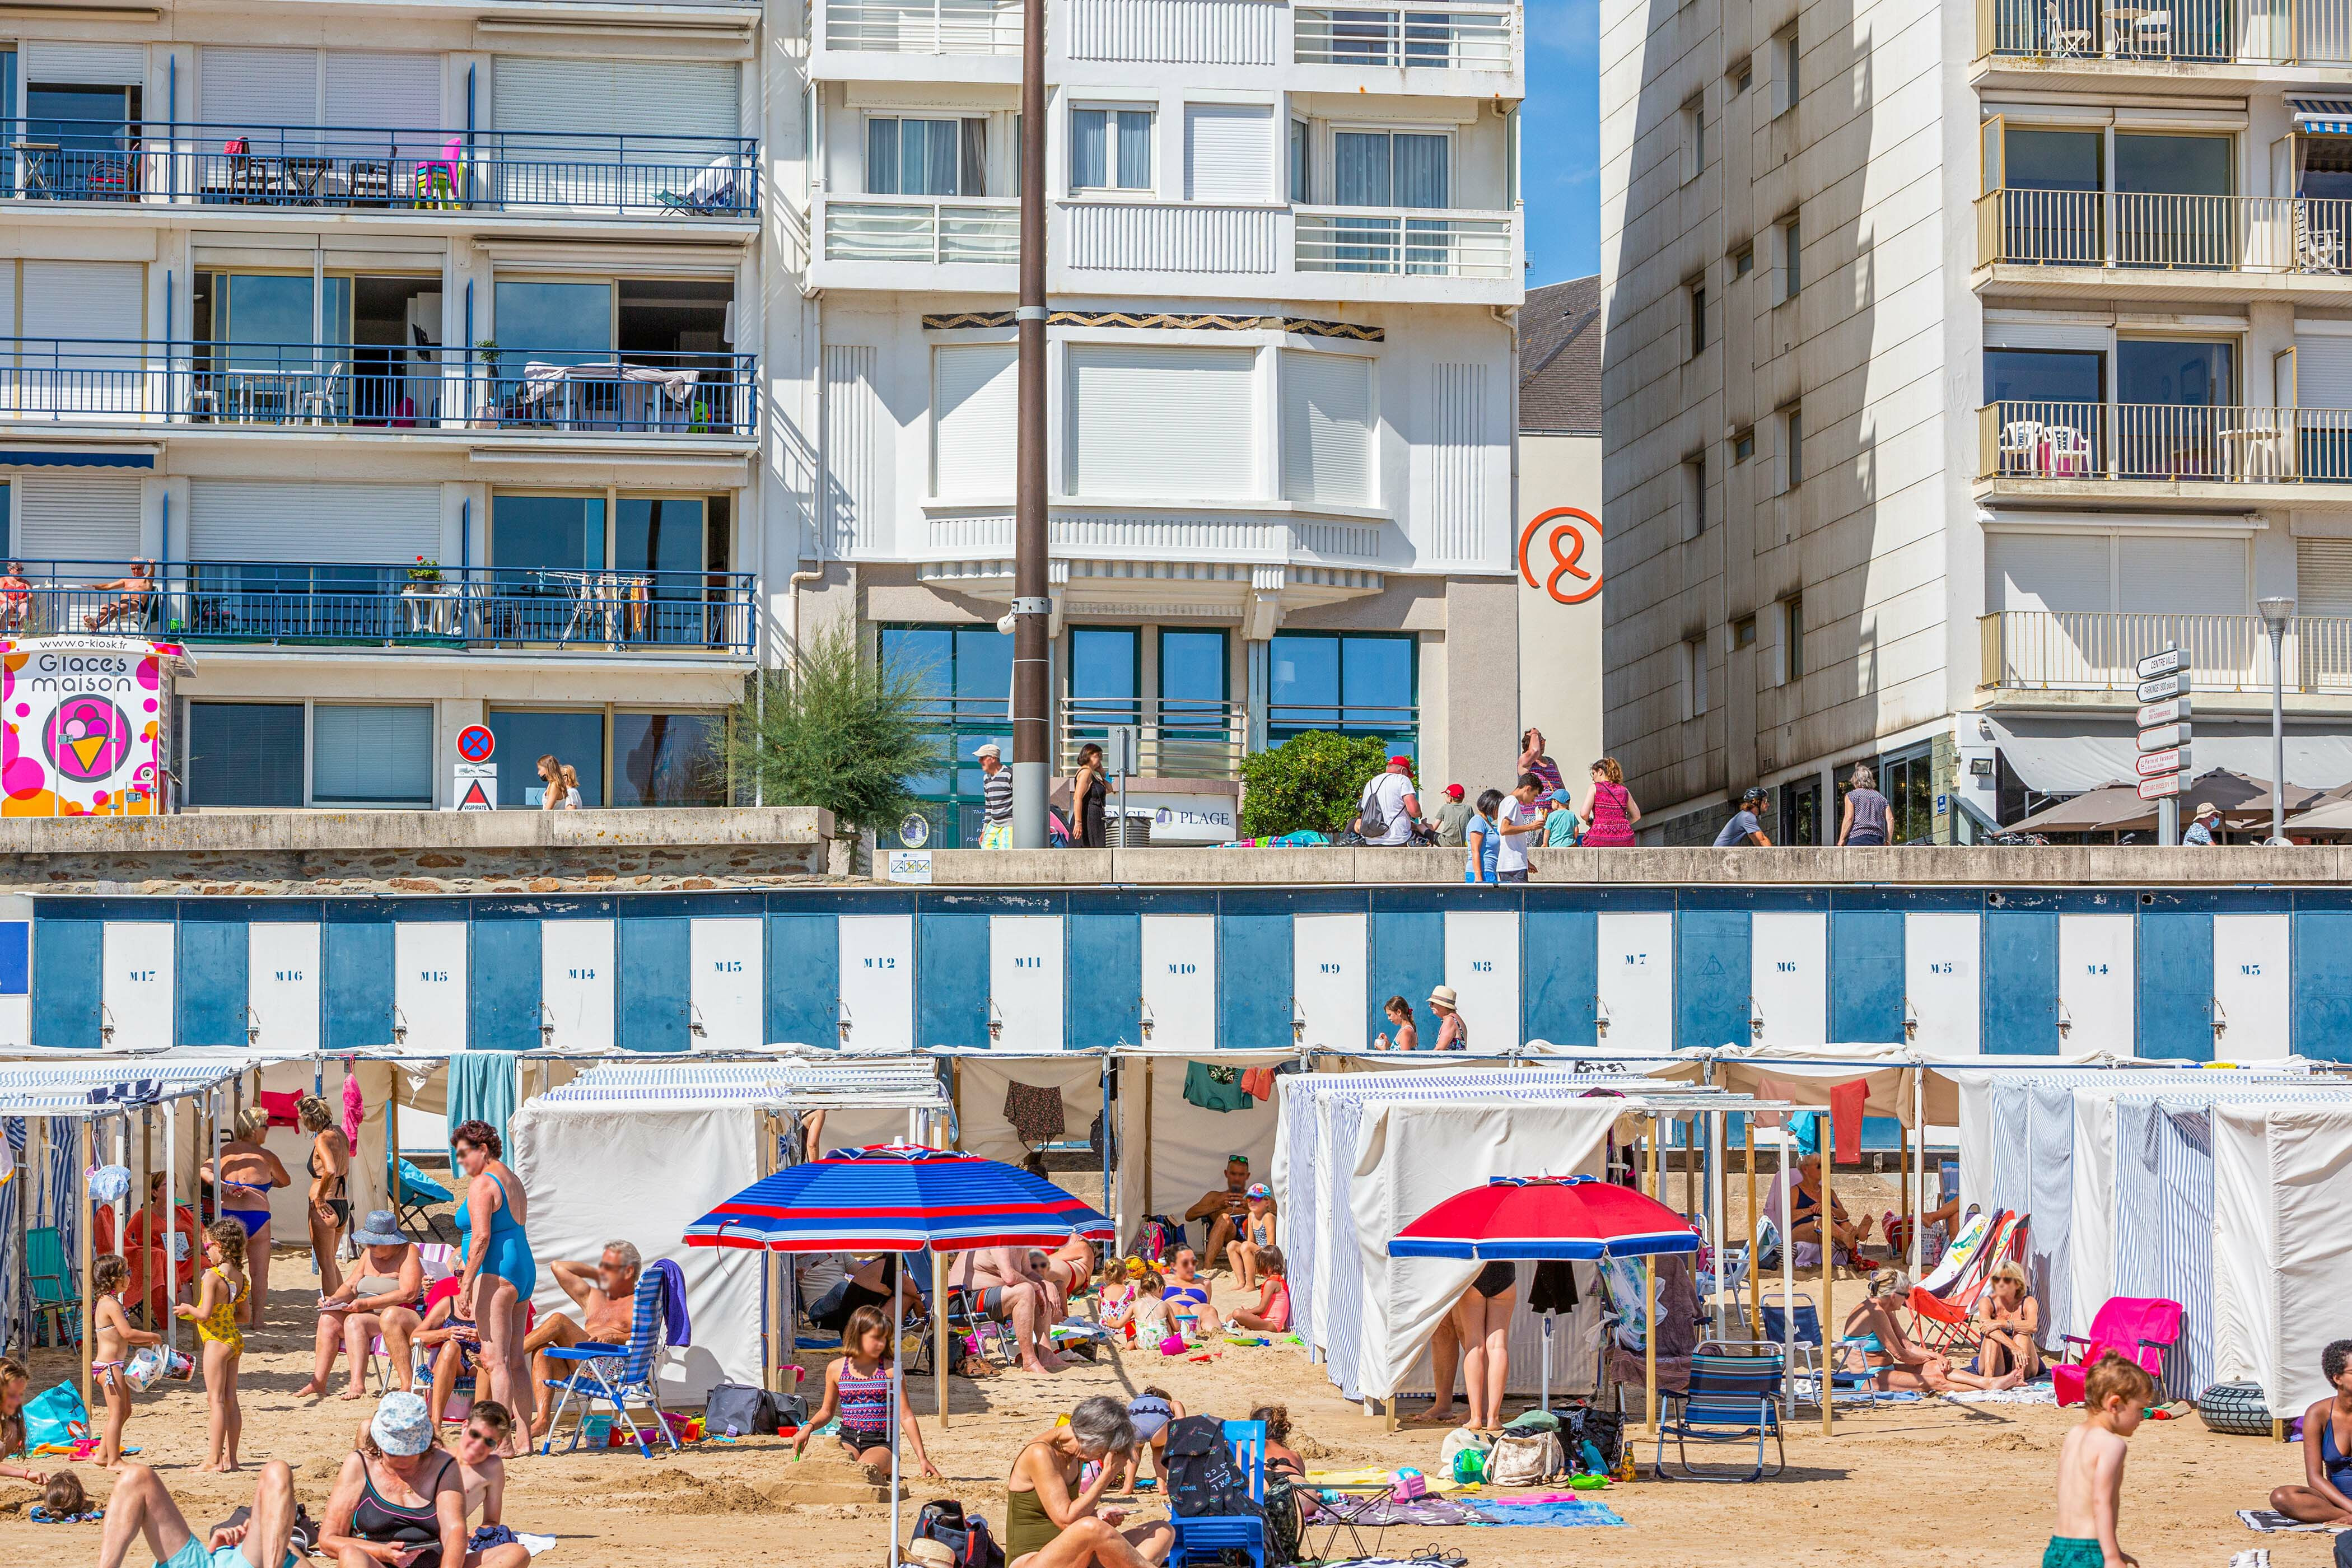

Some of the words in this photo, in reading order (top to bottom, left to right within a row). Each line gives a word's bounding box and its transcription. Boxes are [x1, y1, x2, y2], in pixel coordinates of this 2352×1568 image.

[40, 638, 128, 650] www.o-kiosk.fr
[39, 654, 127, 673] Glaces
[2150, 657, 2166, 670] CENTRE
[2166, 654, 2176, 665] VILLE
[32, 674, 131, 692] maison
[1180, 811, 1230, 825] PLAGE
